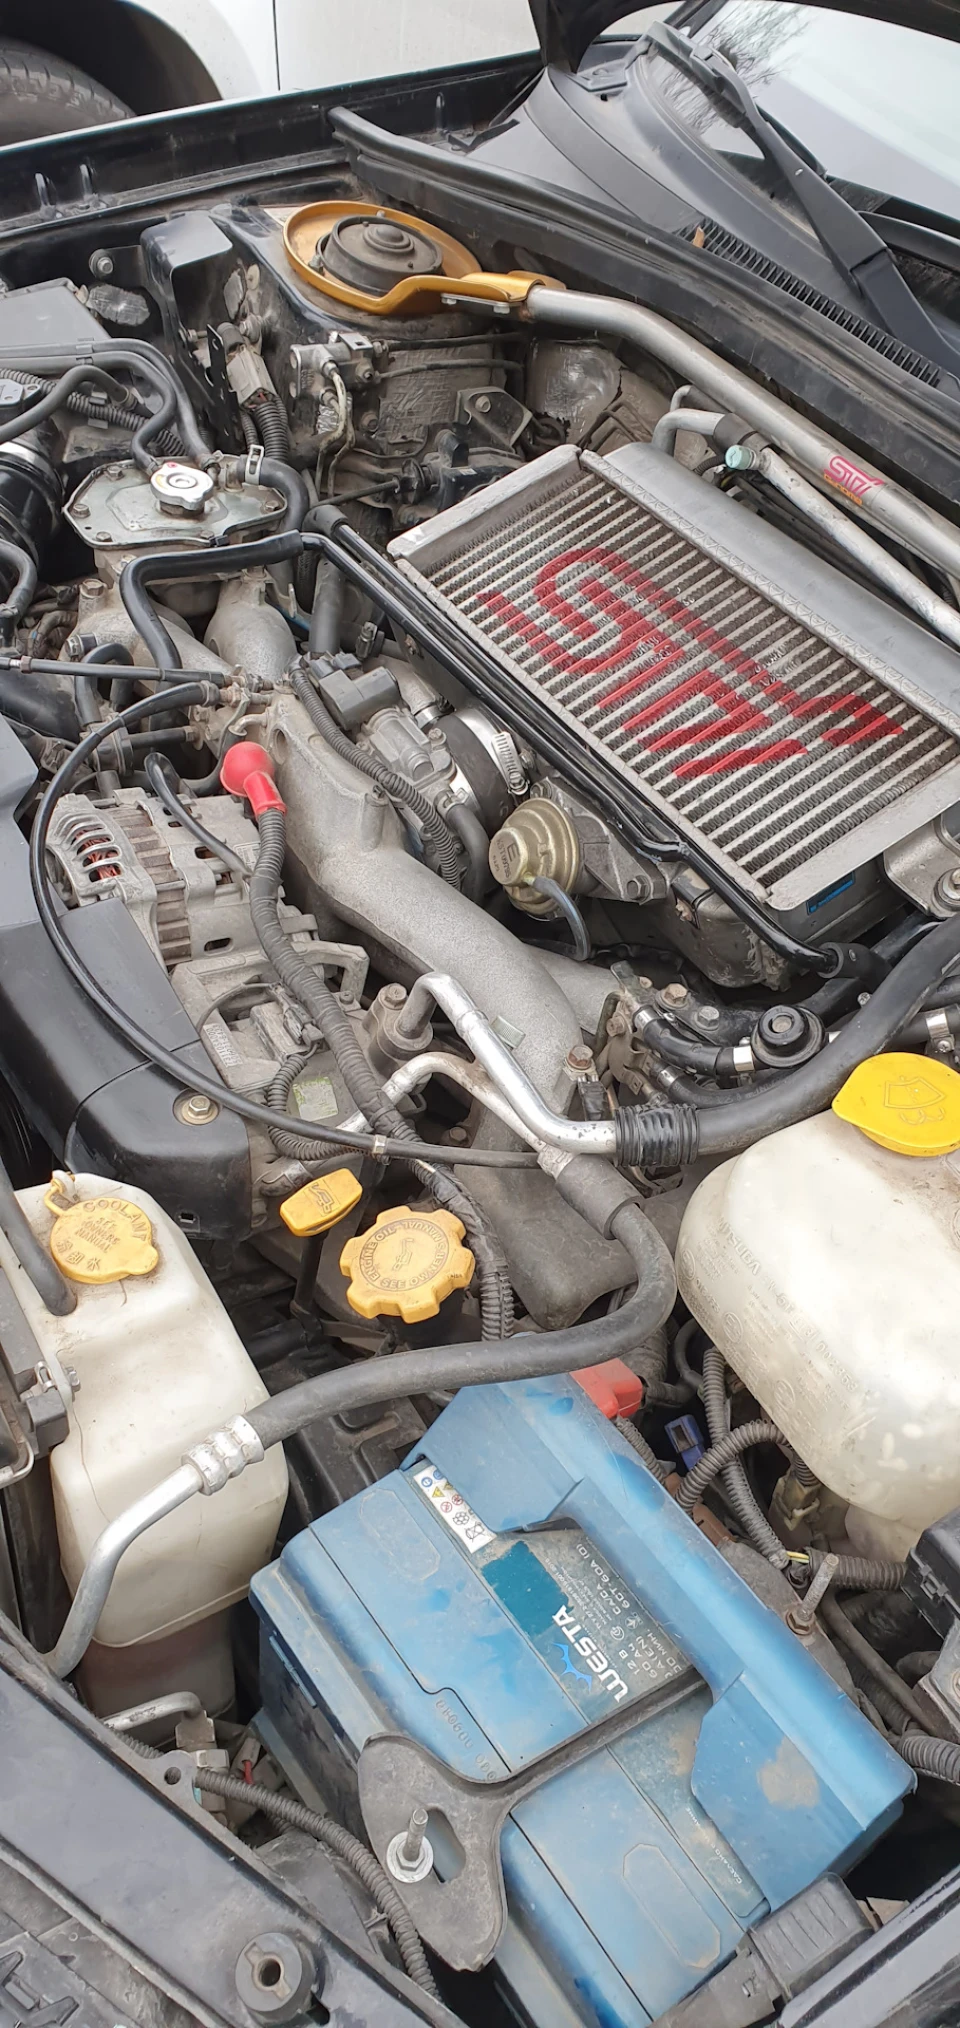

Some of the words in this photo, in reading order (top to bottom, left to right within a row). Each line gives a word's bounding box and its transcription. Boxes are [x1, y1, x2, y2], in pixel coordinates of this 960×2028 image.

[83, 1199, 148, 1242] COOLANT
[96, 1217, 118, 1231] SEE
[75, 1228, 112, 1254] MANUAL
[363, 1241, 381, 1283] ENGINE
[374, 1227, 397, 1242] OIL
[380, 1278, 406, 1289] SEE
[402, 1221, 442, 1243] MANUAL
[551, 1604, 629, 1703] WESTA
[627, 1660, 641, 1676] 12
[641, 1660, 659, 1679] 60
